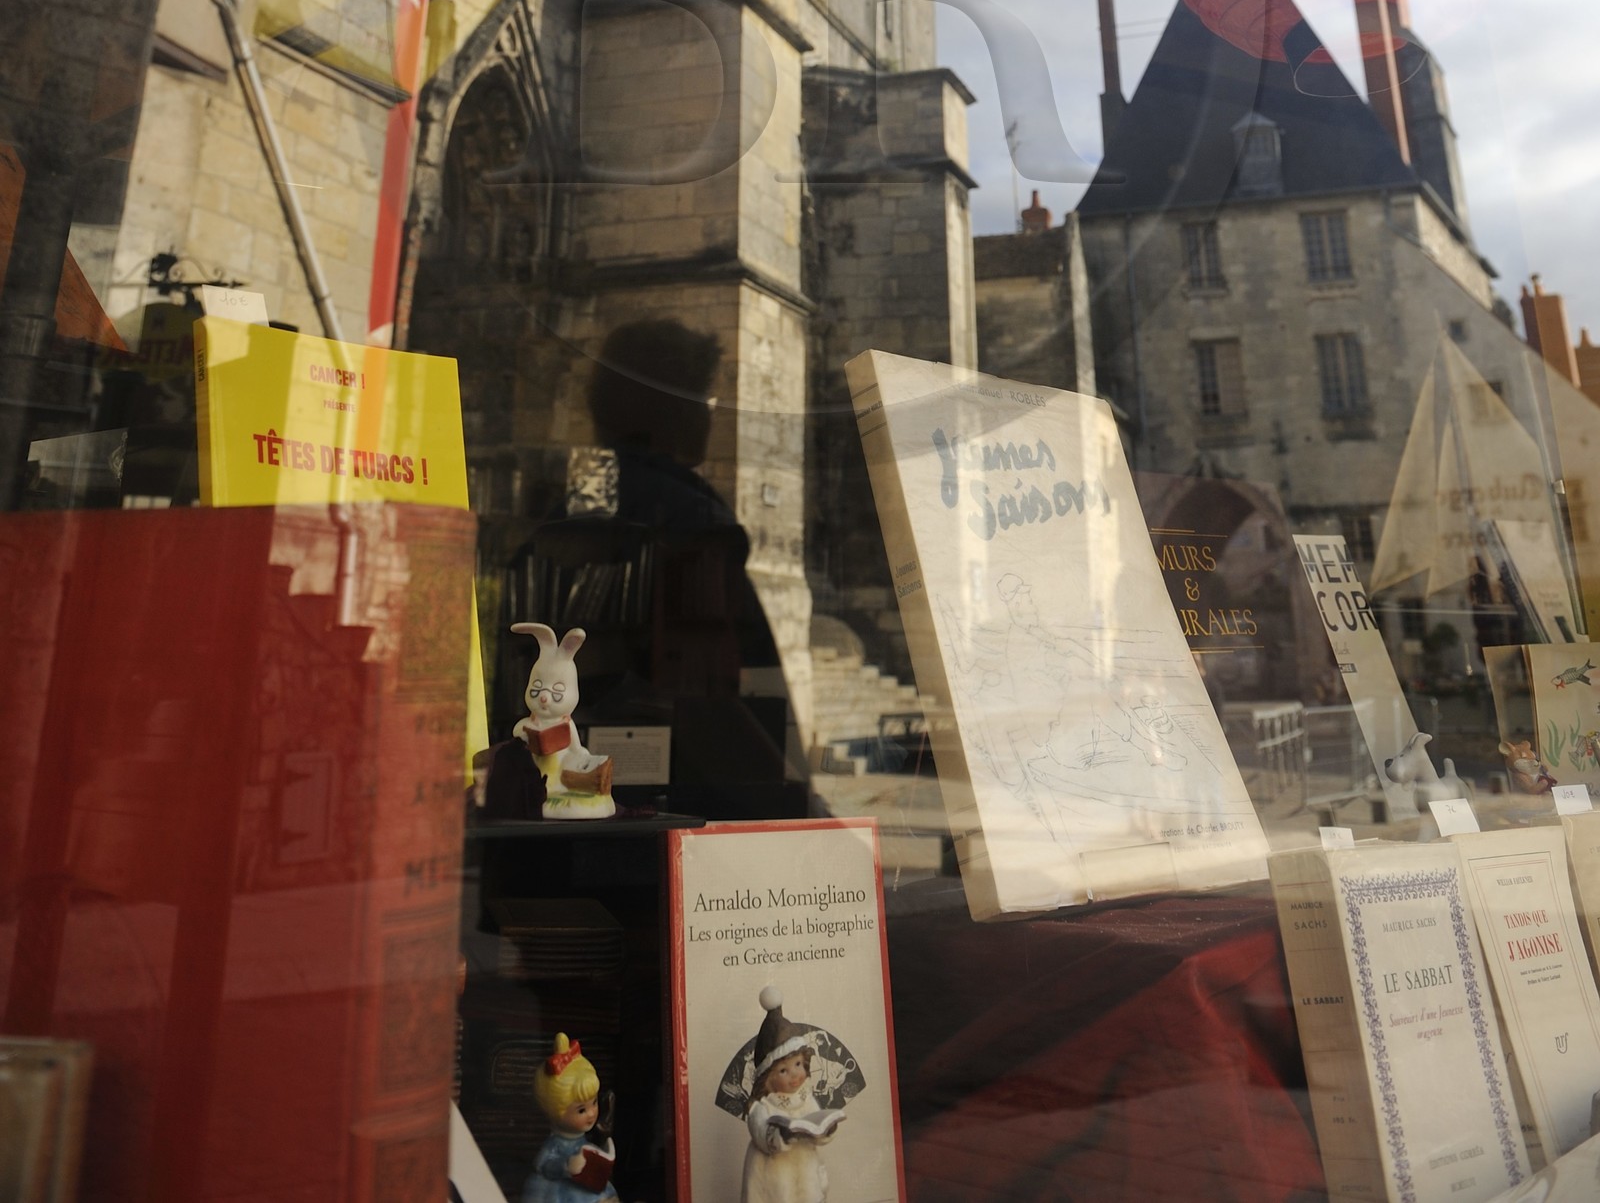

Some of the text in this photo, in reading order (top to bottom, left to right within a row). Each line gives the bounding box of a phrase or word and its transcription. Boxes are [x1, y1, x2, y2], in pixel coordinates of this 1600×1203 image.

[309, 364, 357, 388] CANCER
[253, 428, 316, 472] TÊTES
[320, 444, 348, 476] DE
[350, 450, 416, 485] TURCS
[1157, 545, 1217, 571] MURS
[1184, 578, 1200, 601] &
[1180, 609, 1258, 636] URALES
[693, 884, 866, 913] Arnaldo Momigliano
[688, 914, 875, 944] Les origines de la biographie
[1294, 919, 1328, 930] SACHS
[1382, 920, 1414, 933] MAURICE
[1503, 909, 1549, 929] TANDIS QUE
[722, 944, 846, 967] en Grèce ancienne
[1507, 932, 1563, 962] J'AGONISE
[1383, 964, 1453, 994] LE SABBAT
[1555, 1031, 1569, 1055] nrf
